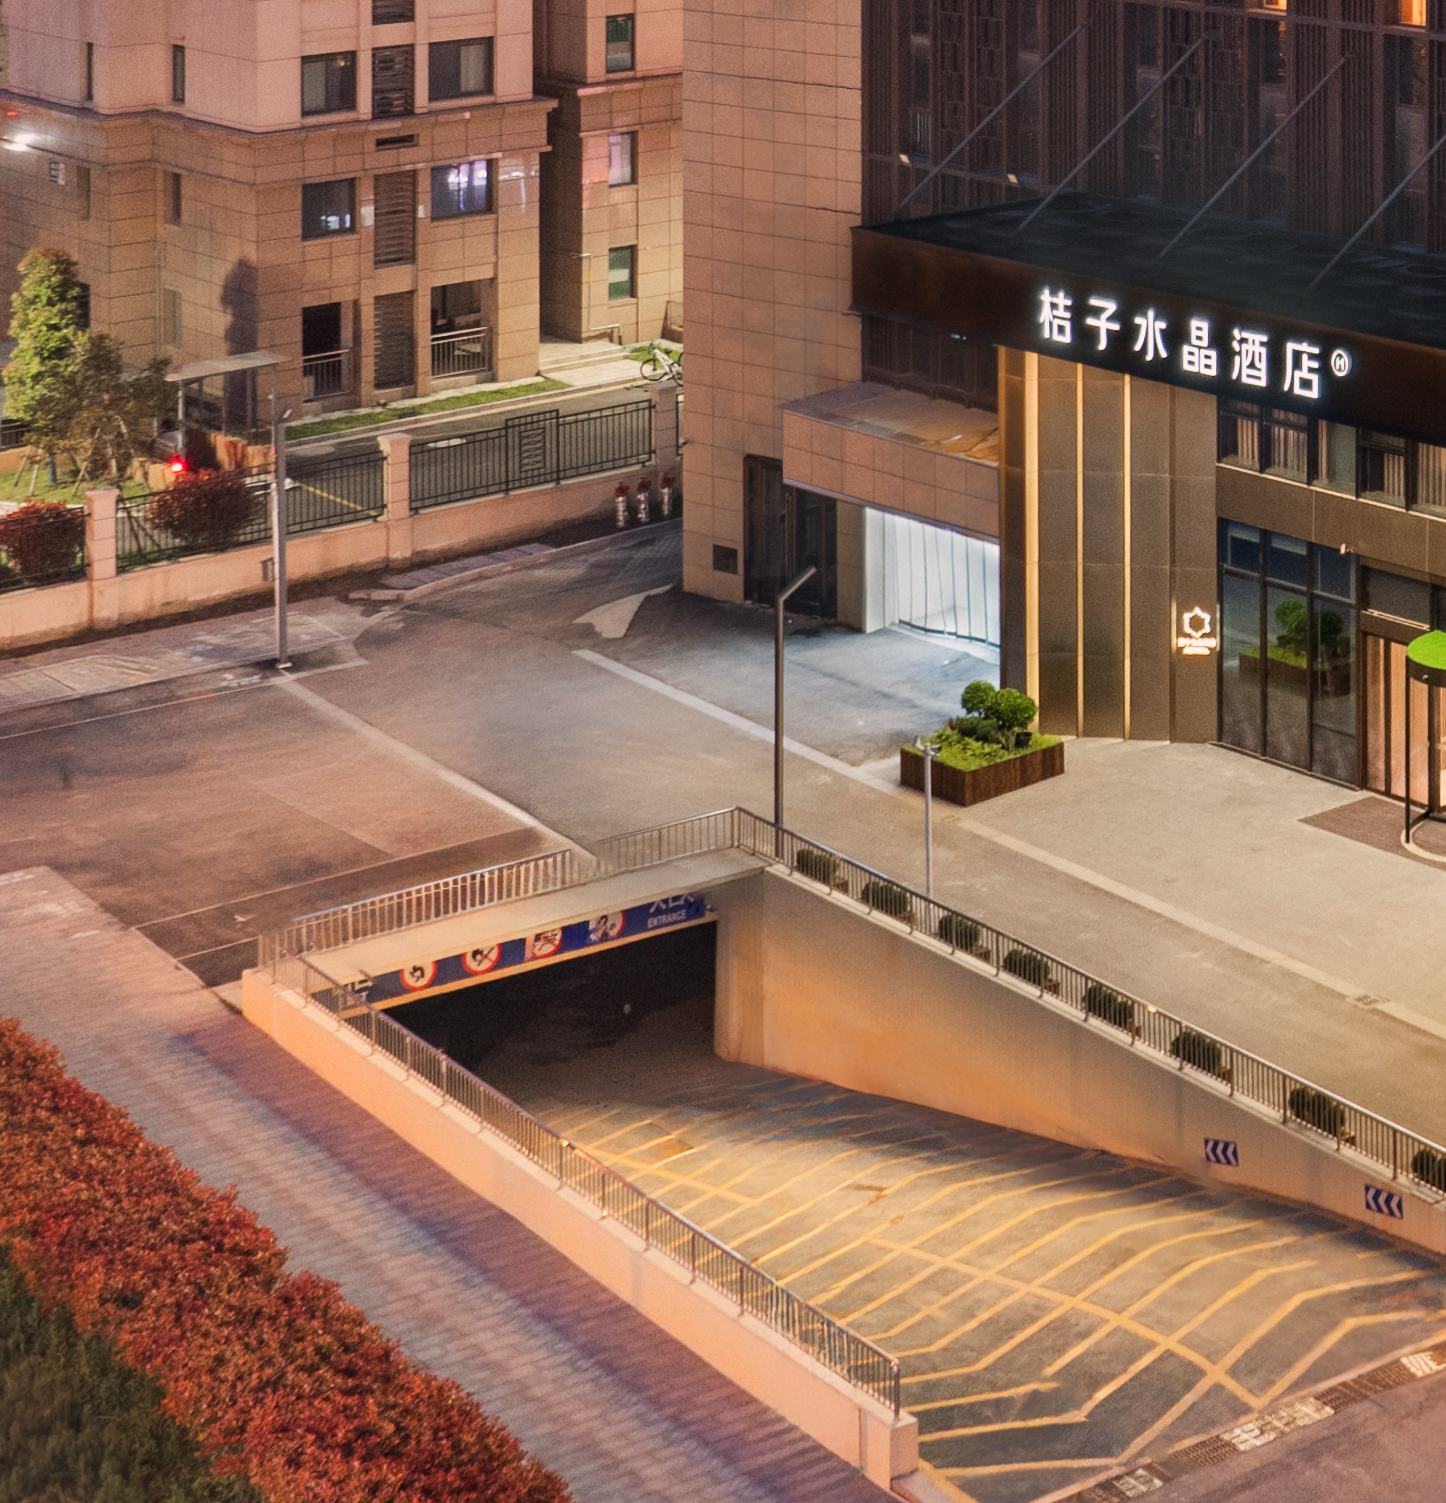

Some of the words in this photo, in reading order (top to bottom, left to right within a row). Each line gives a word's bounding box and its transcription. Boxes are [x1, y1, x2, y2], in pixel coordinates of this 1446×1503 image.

[1038, 286, 1321, 400] 桔子水晶酒店
[647, 909, 687, 929] ENTRANCE
